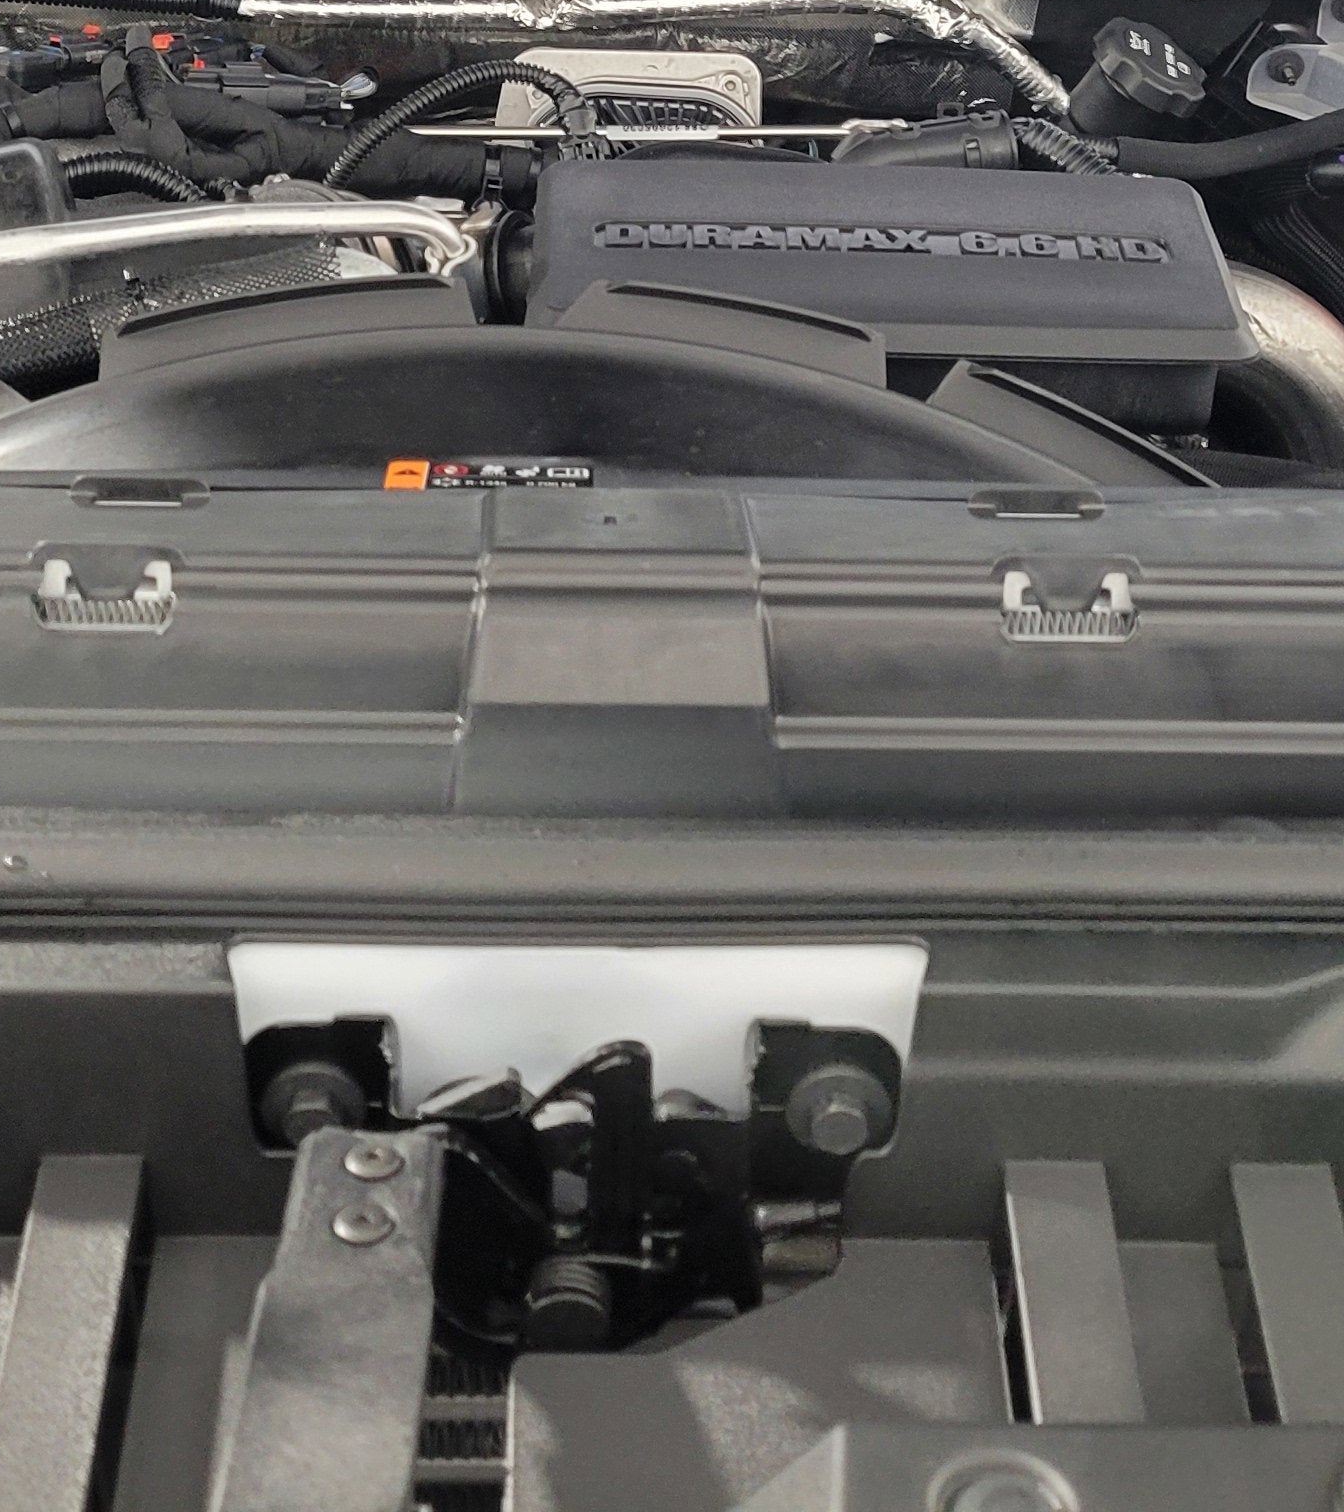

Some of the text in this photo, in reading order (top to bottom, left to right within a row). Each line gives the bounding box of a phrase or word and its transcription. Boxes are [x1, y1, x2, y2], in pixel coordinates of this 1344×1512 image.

[604, 223, 1168, 264] DURAMAX 6.6 HD
